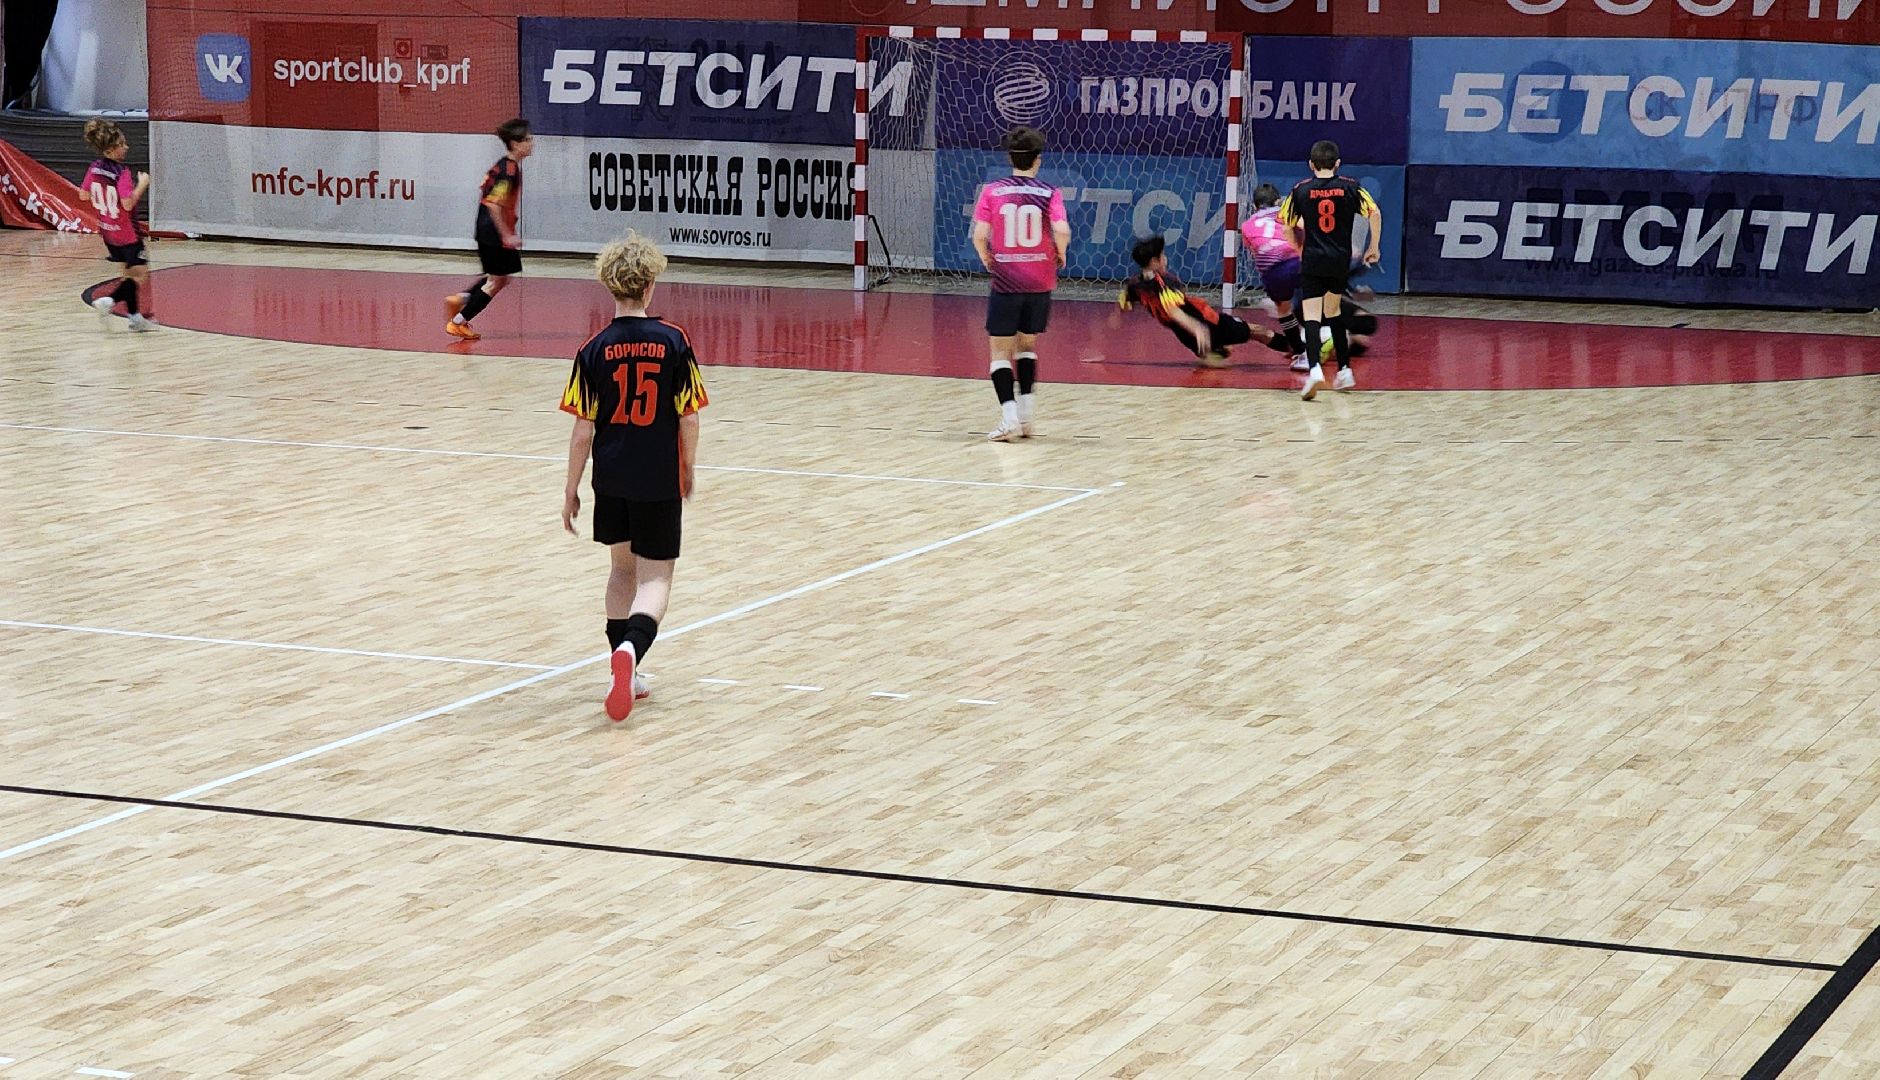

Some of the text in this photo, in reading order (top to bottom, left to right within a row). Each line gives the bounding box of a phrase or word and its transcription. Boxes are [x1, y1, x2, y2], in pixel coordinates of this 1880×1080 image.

[204, 53, 471, 92] VK sportclub_kprf
[543, 49, 913, 117] БЕТСИТИ
[1438, 72, 1880, 145] БЕТСИТИ
[251, 166, 415, 206] mfc-kprf.ru
[588, 151, 856, 221] СОВЕТСКАЯ РОССИЯ
[669, 227, 772, 248] www.sovros.ru
[998, 202, 1043, 248] 10
[1317, 199, 1336, 234] 8
[1433, 200, 1879, 276] БЕТСИТИ
[604, 342, 666, 361] БОРИСОВ
[610, 361, 662, 427] 15
